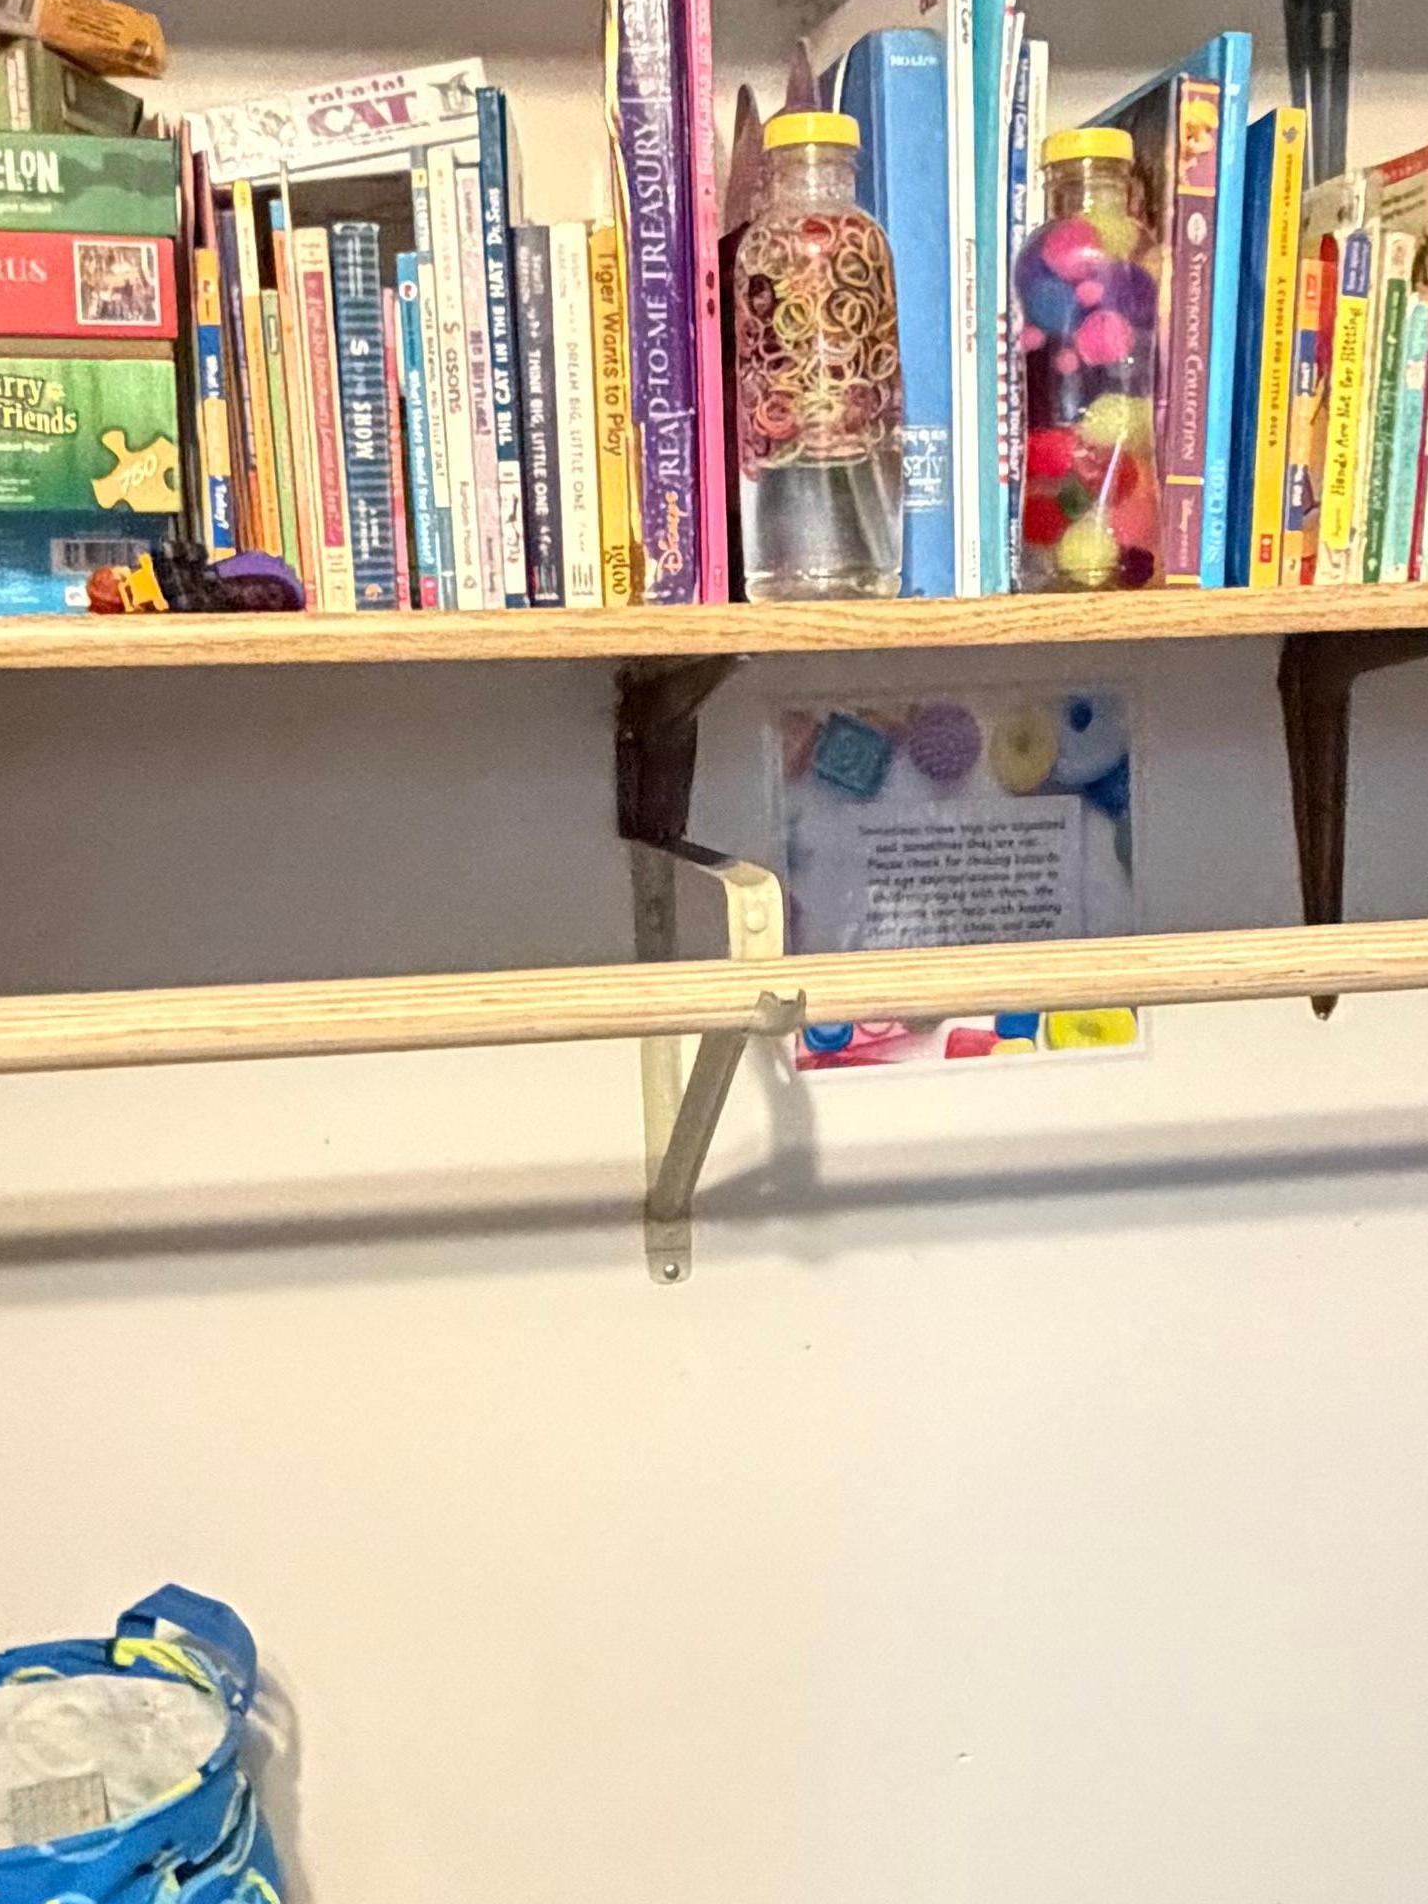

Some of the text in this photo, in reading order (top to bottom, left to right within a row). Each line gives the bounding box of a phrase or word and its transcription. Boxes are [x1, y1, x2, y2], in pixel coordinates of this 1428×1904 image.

[306, 90, 417, 139] CAT
[634, 121, 668, 288] TREASURY
[488, 258, 505, 298] HAT
[965, 278, 975, 311] Head
[491, 305, 507, 338] THE
[965, 314, 974, 330] to
[1339, 307, 1364, 363] Hitting
[494, 342, 508, 363] IN
[528, 349, 543, 394] THINK
[594, 251, 625, 457] Tiger Wants to Play
[1181, 252, 1208, 462] STORYBOOK COLLECTION
[493, 367, 512, 405] CAT
[1270, 369, 1282, 411] LITTLE
[1339, 367, 1355, 387] for
[1337, 395, 1352, 419] Not
[353, 401, 375, 460] SNOW
[496, 411, 513, 446] THE
[1334, 423, 1350, 448] Are
[531, 432, 548, 480] LITTLE
[1330, 452, 1349, 497] Hands
[213, 487, 230, 531] Today?
[533, 481, 550, 516] ONE
[572, 480, 586, 512] ONE
[604, 543, 630, 596] igloo
